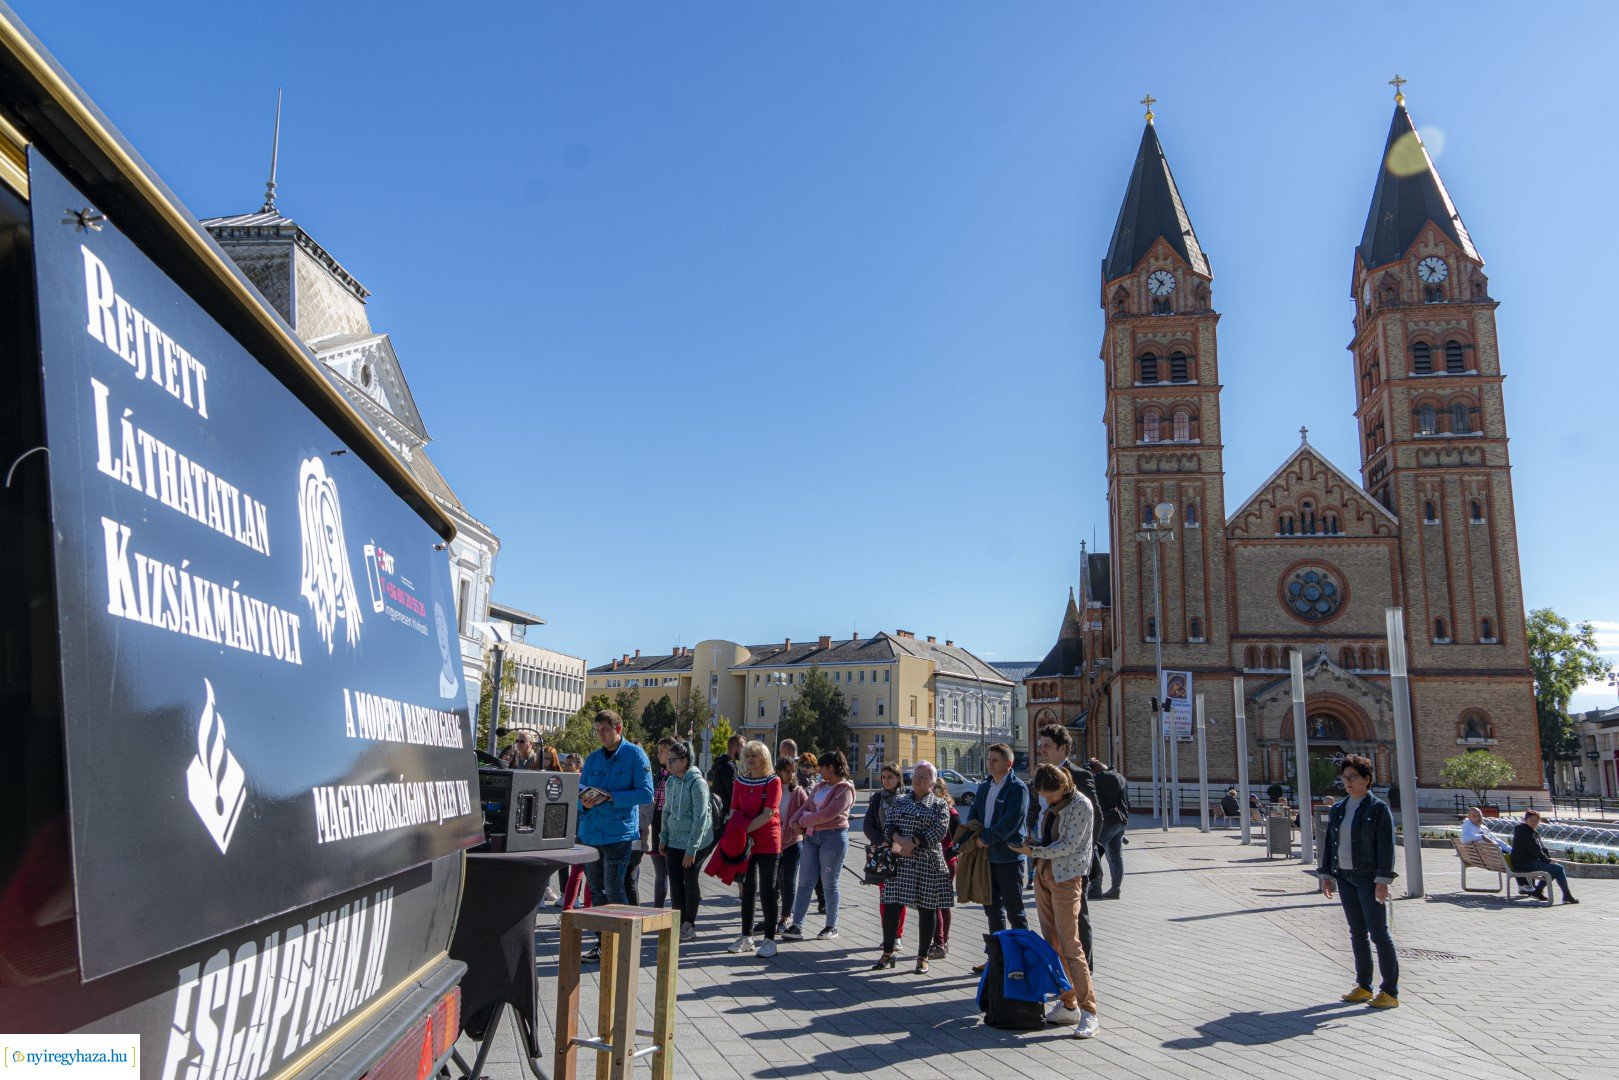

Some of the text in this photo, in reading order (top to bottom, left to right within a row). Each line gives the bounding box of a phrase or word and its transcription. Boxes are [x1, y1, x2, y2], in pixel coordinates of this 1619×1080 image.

[81, 244, 208, 419] REJTETT
[91, 377, 270, 556] LÁTHATATLAN
[101, 517, 302, 664] KIZSÁKMÁNYOLT
[343, 688, 464, 749] A MODERN RABSZOLGASÁG
[312, 774, 472, 844] MAGYARORSZÁGON IS JELEN VAN
